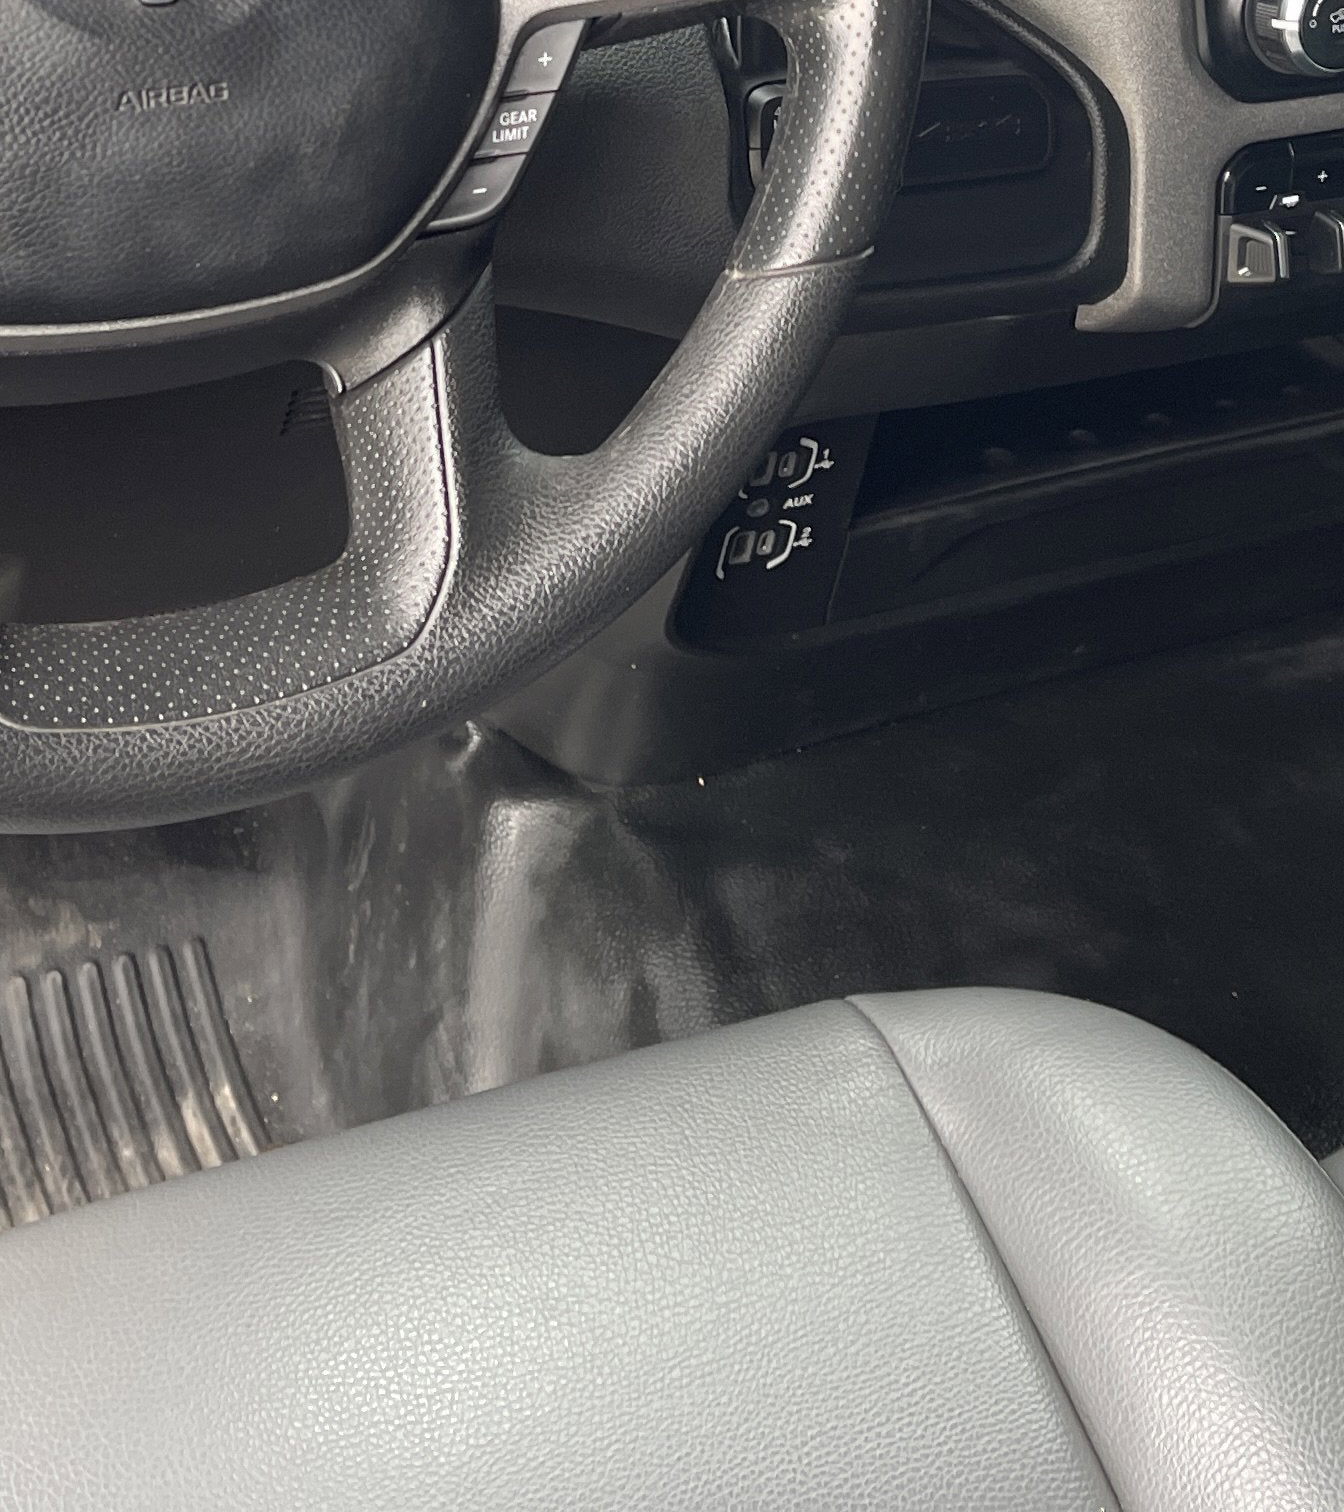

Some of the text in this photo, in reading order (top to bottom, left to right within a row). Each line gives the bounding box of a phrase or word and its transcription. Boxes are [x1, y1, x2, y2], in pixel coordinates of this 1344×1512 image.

[115, 81, 230, 113] AIRBAG
[499, 109, 538, 126] GEAR
[492, 126, 530, 144] LIMIT
[783, 494, 814, 509] AUX
